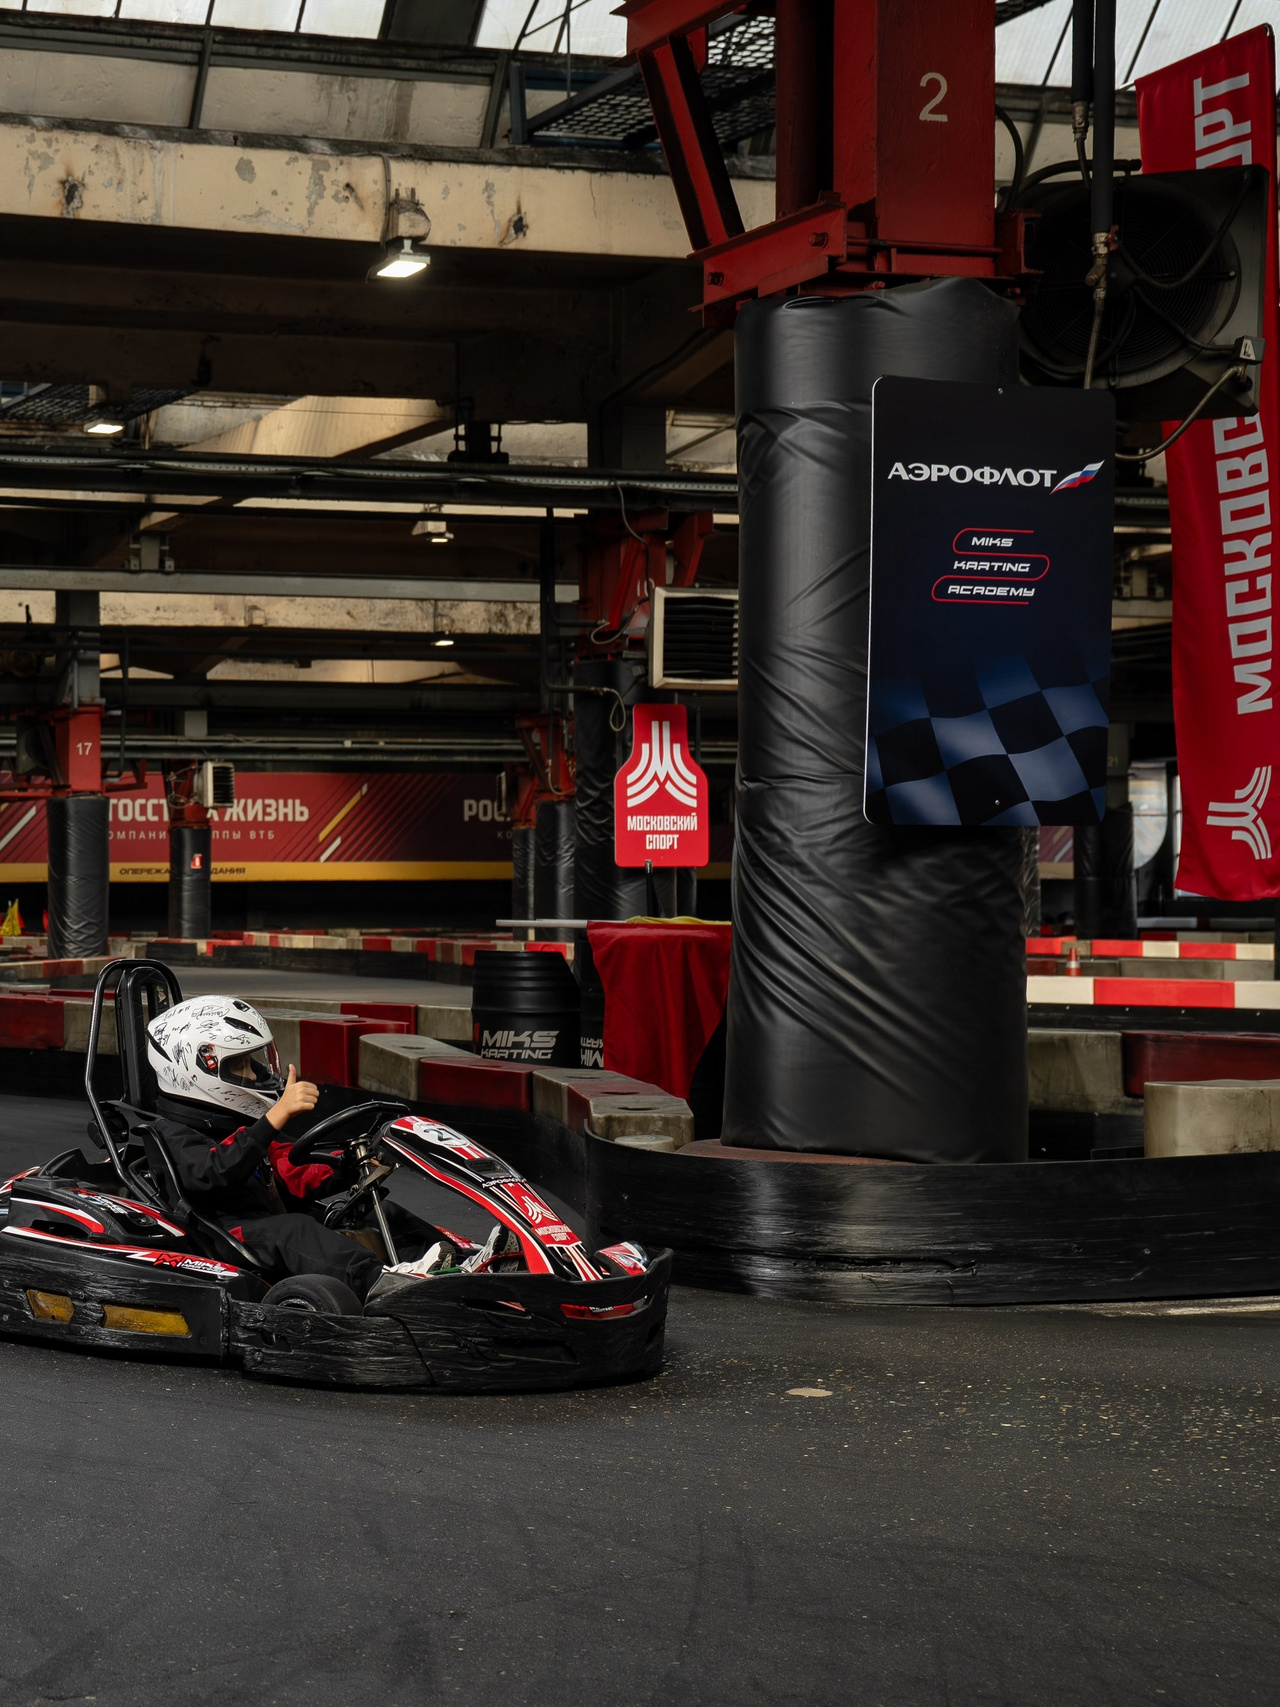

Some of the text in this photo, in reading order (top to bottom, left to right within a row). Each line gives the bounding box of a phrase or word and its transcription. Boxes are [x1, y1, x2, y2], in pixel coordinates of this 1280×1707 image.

[919, 72, 949, 123] 2
[887, 461, 1058, 488] АЭРОФЛОТ
[971, 536, 1014, 548] MIKS
[953, 560, 1031, 573] KARTING
[1212, 410, 1274, 716] МОСКОВС
[947, 585, 1036, 598] ACADEMY
[75, 742, 93, 756] 17
[224, 798, 310, 822] ЖИЗНЬ
[627, 812, 698, 831] МОСКОВСКИЙ
[249, 830, 275, 840] ВТБ
[645, 833, 679, 850] СПОРТ
[119, 867, 169, 876] ОПЕРЕЖА
[481, 1030, 560, 1048] MIKS
[480, 1049, 554, 1059] KARTING
